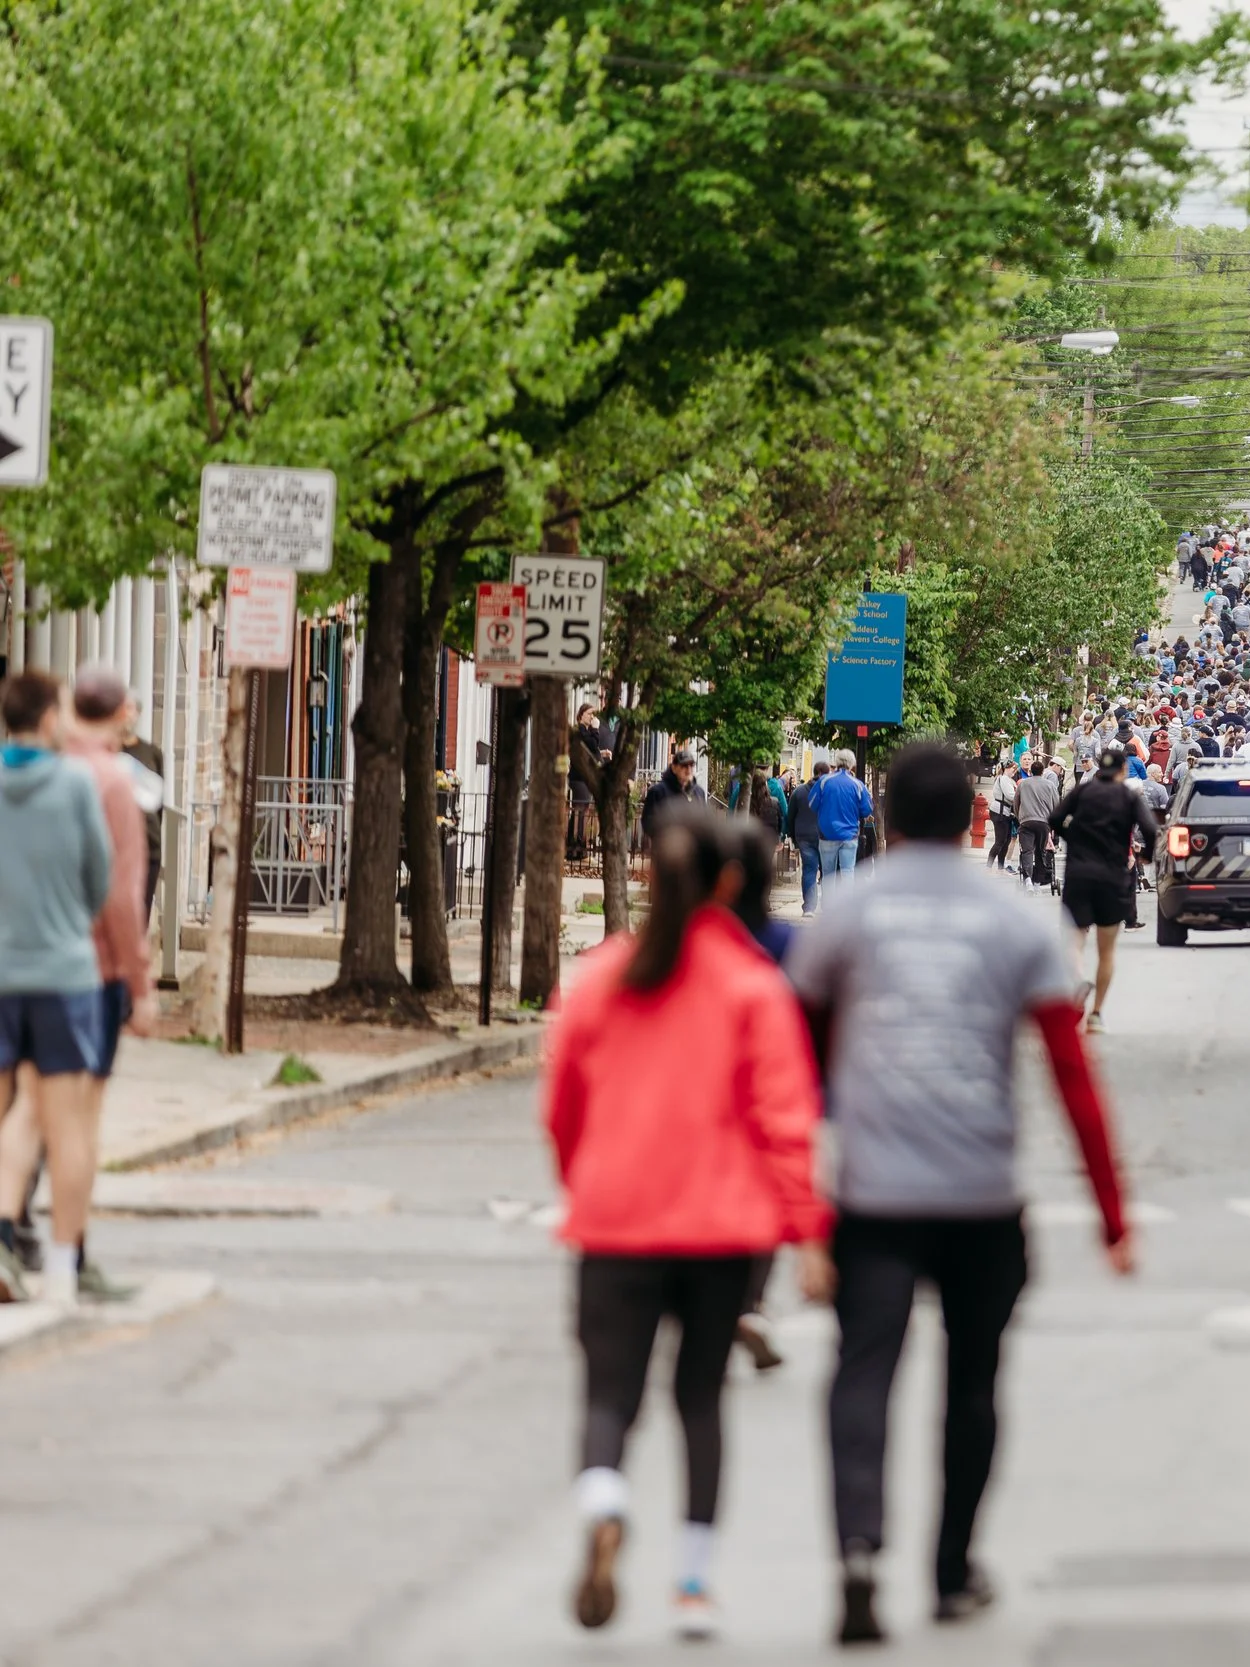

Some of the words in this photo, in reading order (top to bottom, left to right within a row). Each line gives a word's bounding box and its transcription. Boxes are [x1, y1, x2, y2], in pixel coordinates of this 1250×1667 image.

[521, 568, 597, 589] SPEED
[527, 593, 586, 612] LIMIT
[863, 610, 888, 619] School
[525, 617, 591, 660] 25
[872, 635, 900, 646] College
[842, 655, 868, 665] Science
[870, 656, 897, 667] Factory
